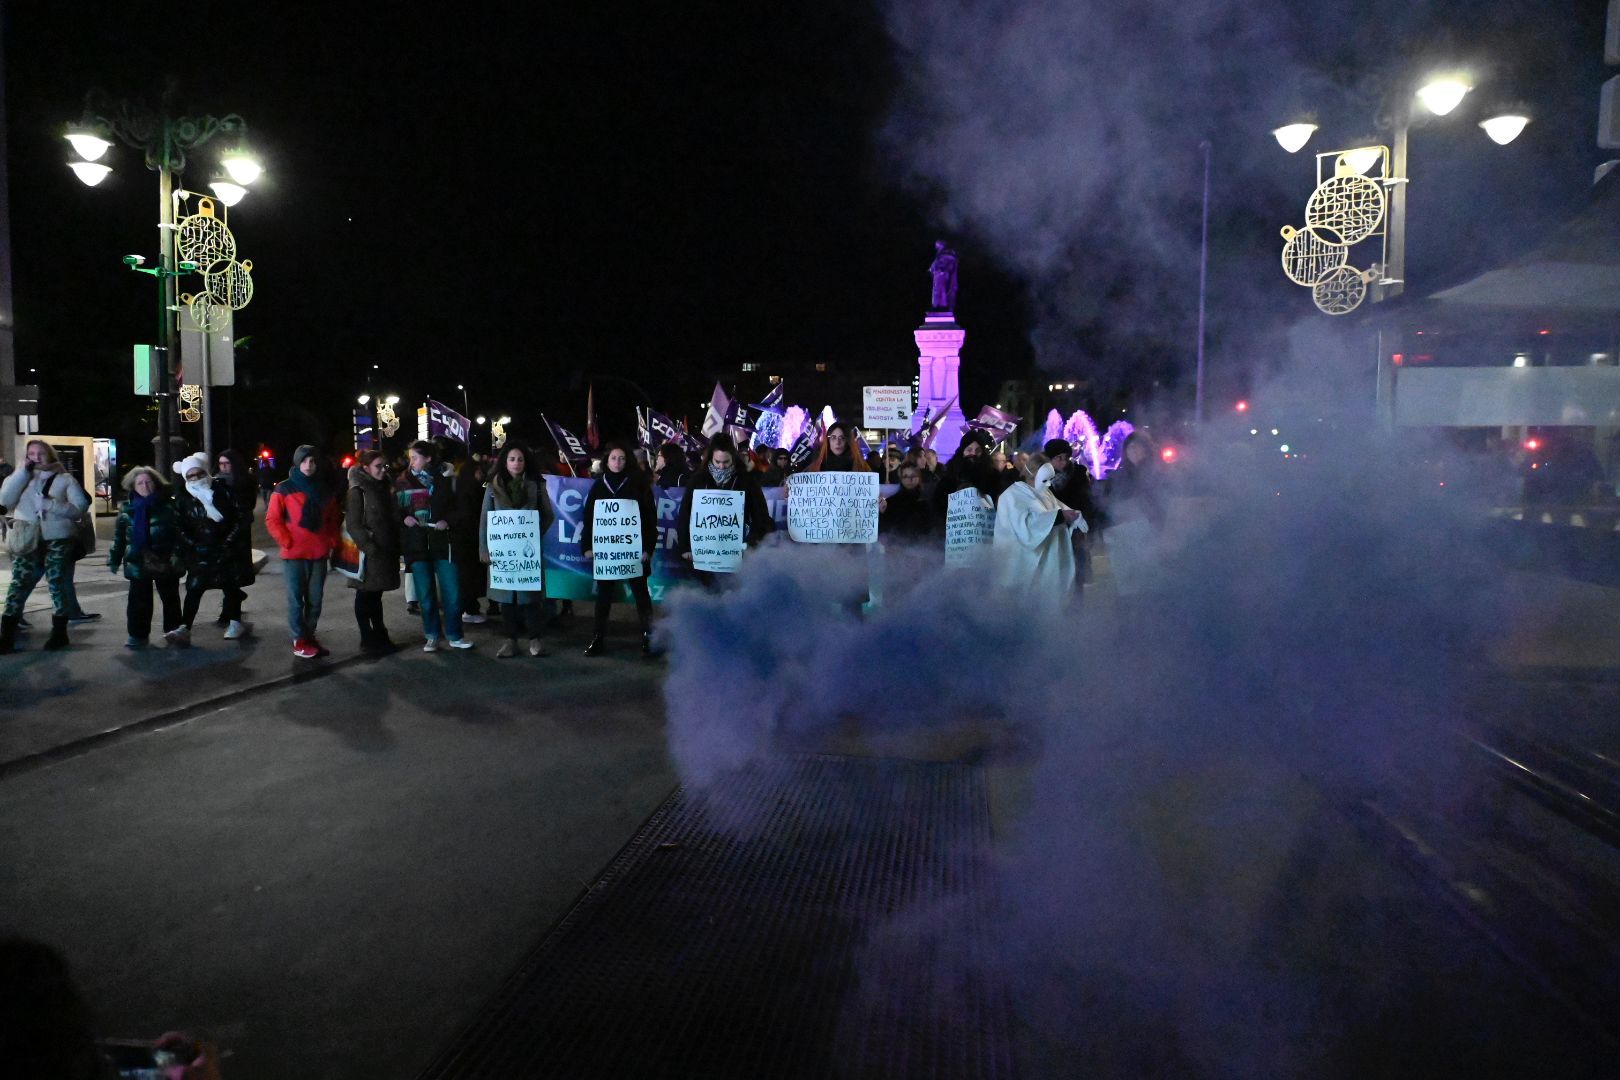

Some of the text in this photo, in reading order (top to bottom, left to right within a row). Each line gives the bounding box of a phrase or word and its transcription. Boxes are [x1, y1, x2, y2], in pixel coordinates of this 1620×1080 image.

[829, 474, 840, 485] DE
[842, 474, 856, 485] LOS
[858, 474, 875, 485] QUE
[789, 486, 803, 497] HOY
[854, 486, 872, 497] VAN
[789, 497, 878, 508] A EMPEZAR A SOLTAR
[789, 508, 801, 518] LA
[801, 508, 834, 518] MIERDA
[835, 508, 852, 518] QUE
[856, 508, 862, 518] A
[864, 510, 878, 519] LAS
[491, 515, 515, 526] CADA
[595, 515, 638, 527] TODOS LOS
[695, 511, 707, 529] LA
[789, 518, 875, 529] MUJERES NOS HAN
[489, 533, 501, 541] UNA
[503, 532, 527, 540] MUJER
[805, 529, 874, 540] HECHO PASAR?
[594, 551, 640, 561] PERO SIEMPRE
[595, 564, 637, 576] UN HOMBRE
[492, 575, 504, 584] POR
